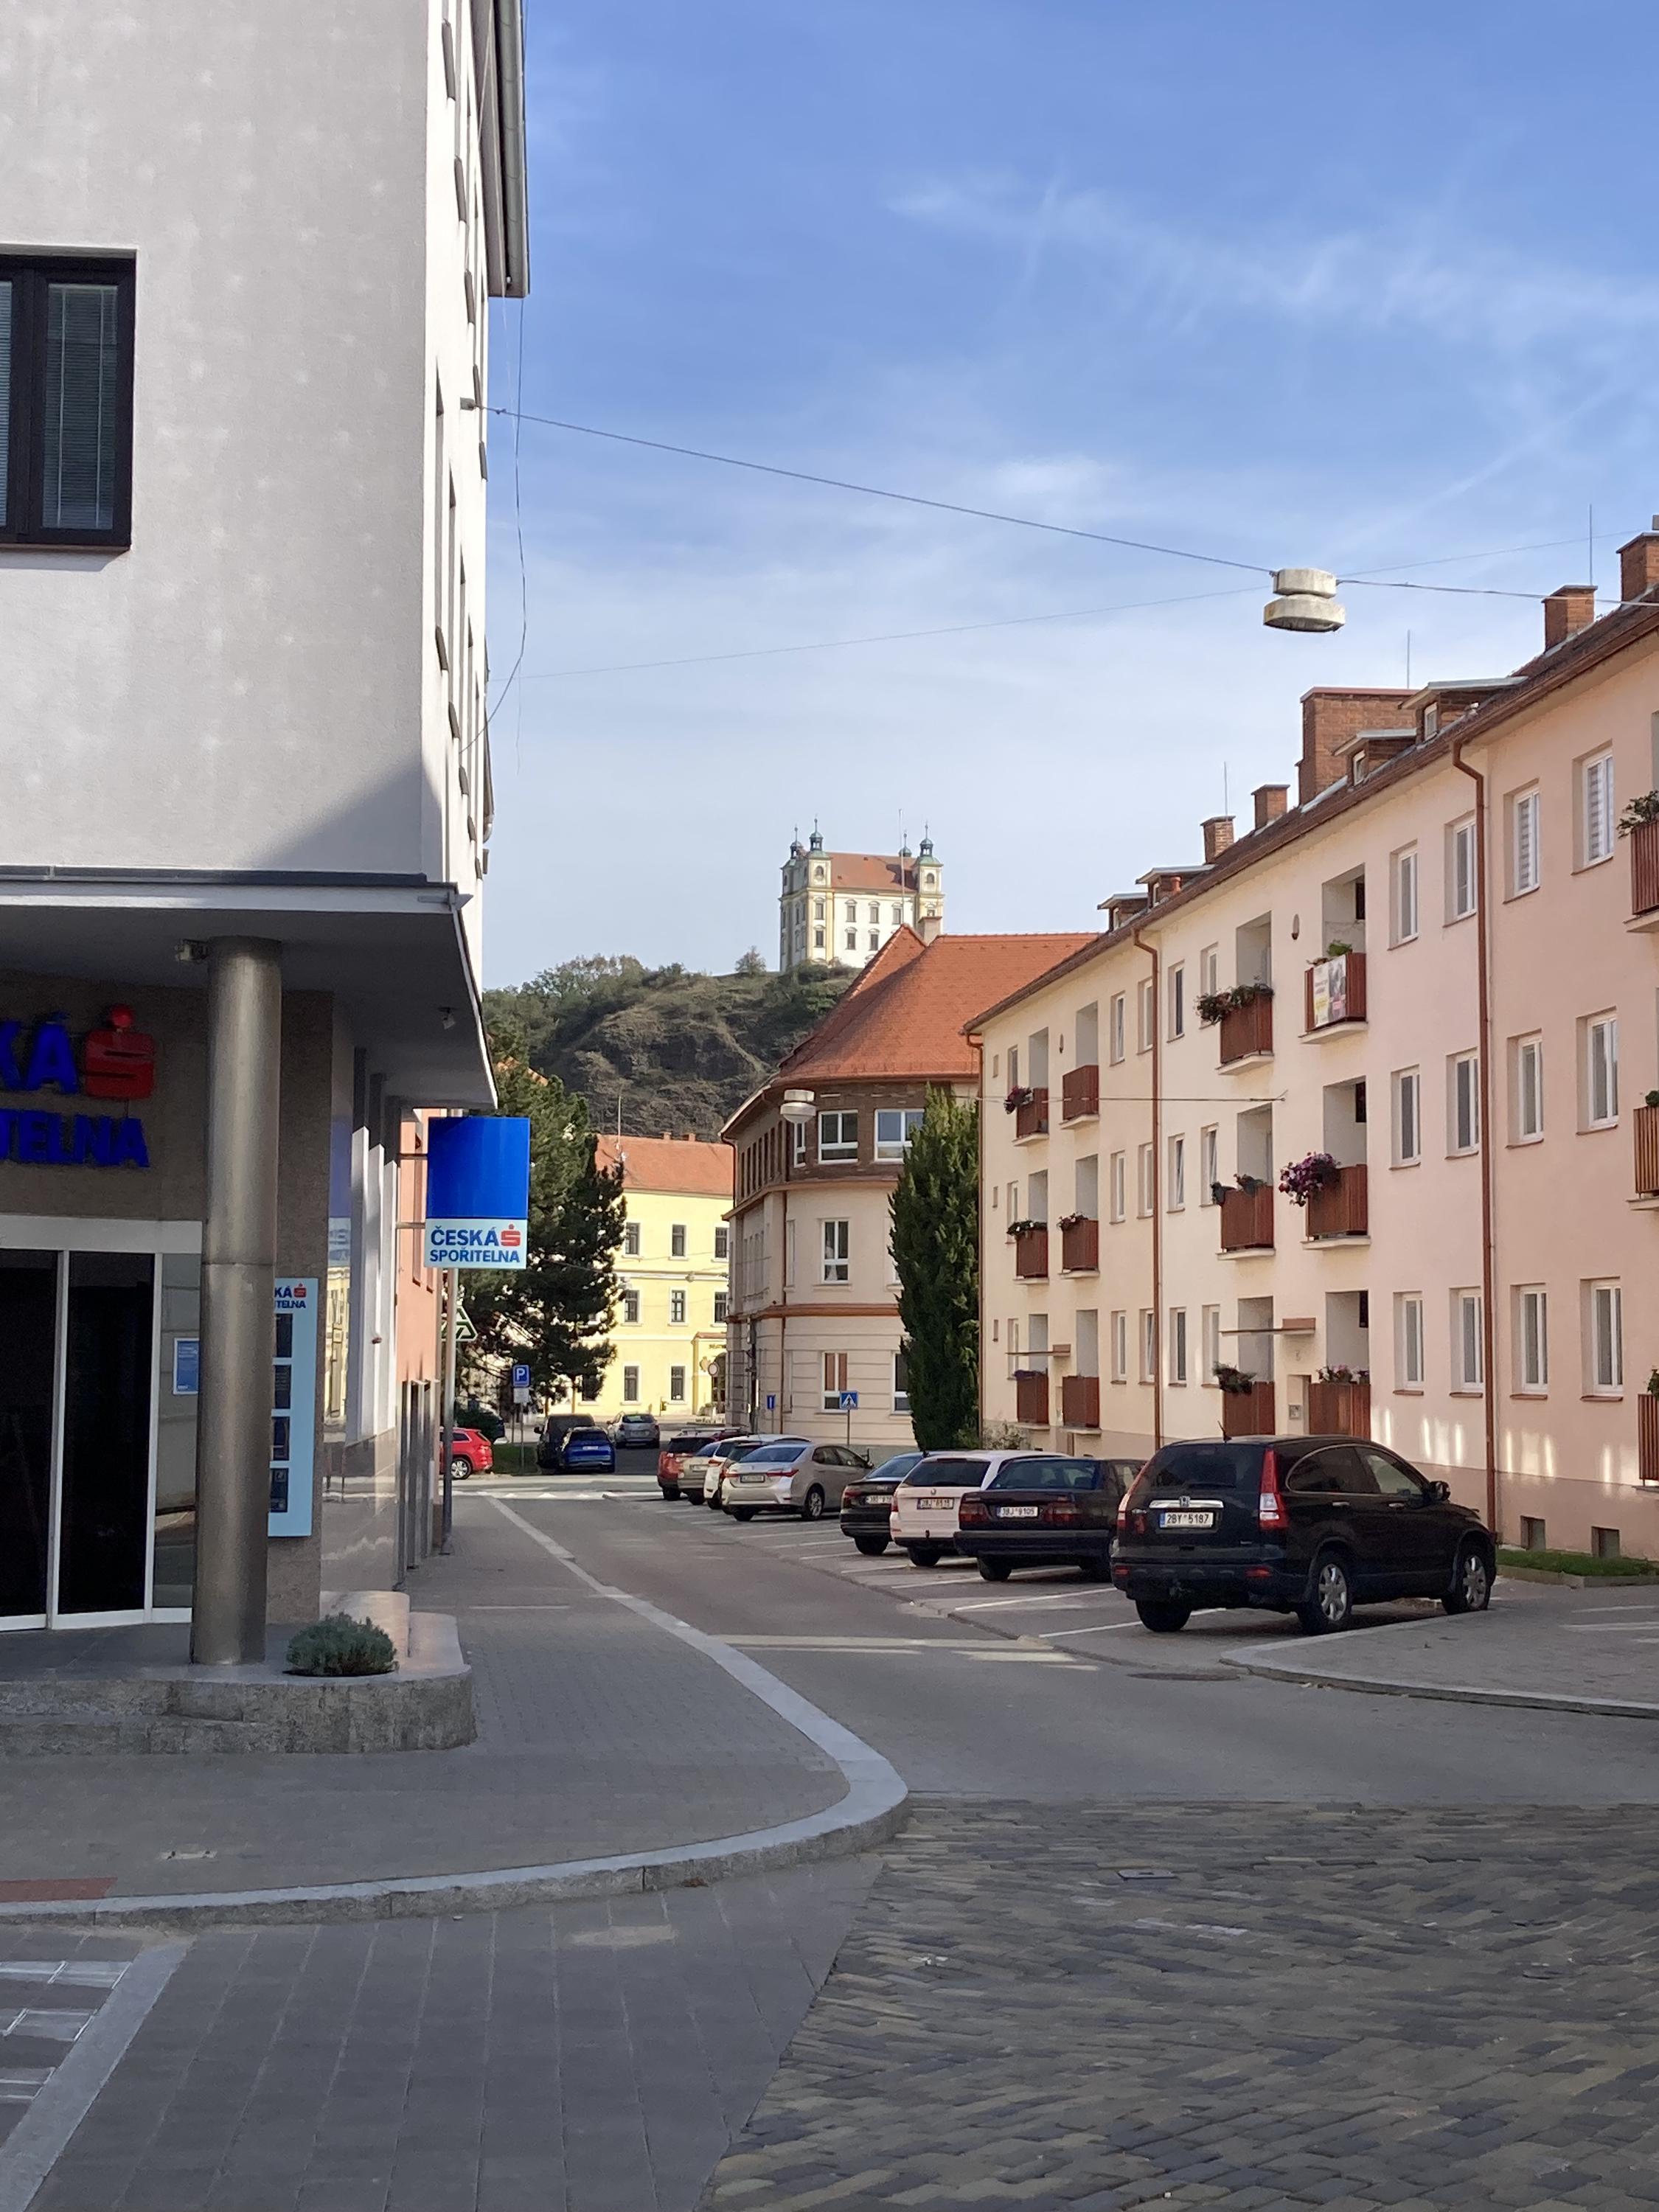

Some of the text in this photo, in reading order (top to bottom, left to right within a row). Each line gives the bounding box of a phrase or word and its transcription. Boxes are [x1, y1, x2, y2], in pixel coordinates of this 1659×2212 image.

[431, 1225, 499, 1246] ČESKÁ
[429, 1246, 521, 1263] SPOŘITELNA
[516, 1368, 526, 1381] P
[1166, 1514, 1183, 1524] 2BY
